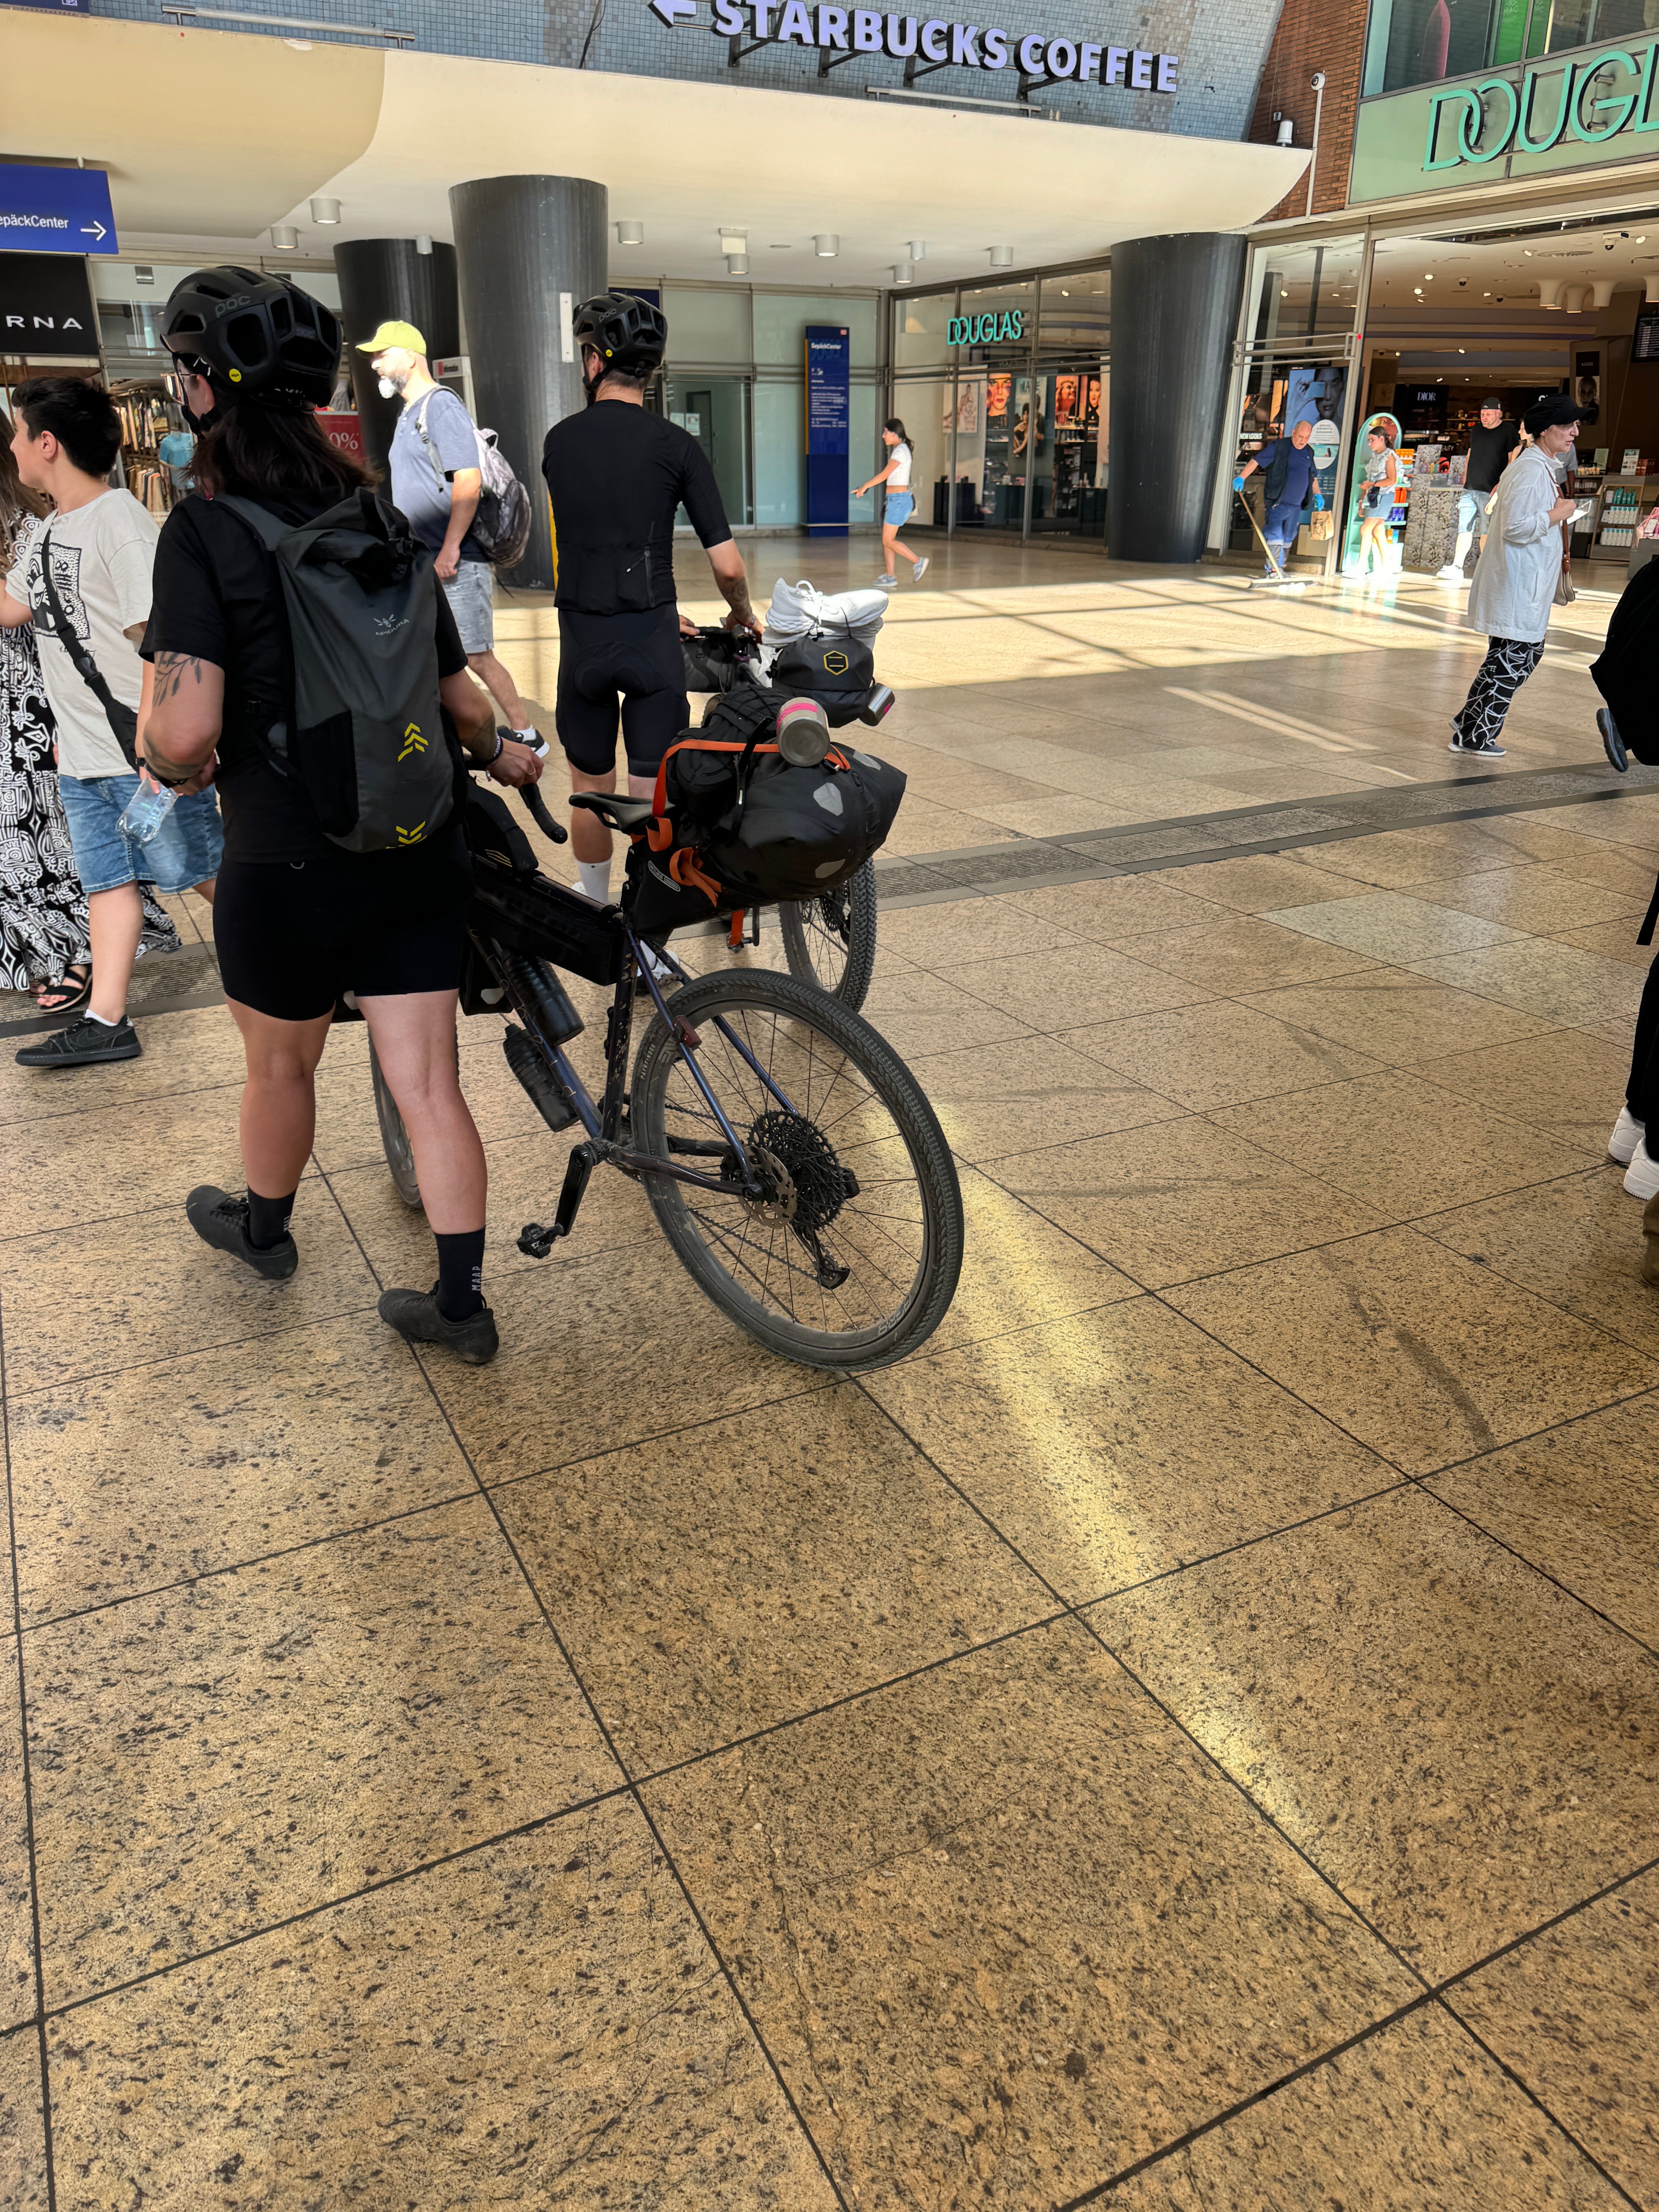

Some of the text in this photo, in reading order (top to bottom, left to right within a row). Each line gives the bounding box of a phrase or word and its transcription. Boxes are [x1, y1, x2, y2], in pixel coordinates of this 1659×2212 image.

[714, 0, 1179, 92] STARBUCKS COFFEE
[1424, 43, 1659, 171] DOUGL
[947, 310, 1022, 345] DOUGLAS
[1417, 392, 1436, 401] DIOR
[471, 1266, 481, 1291] MAAP
